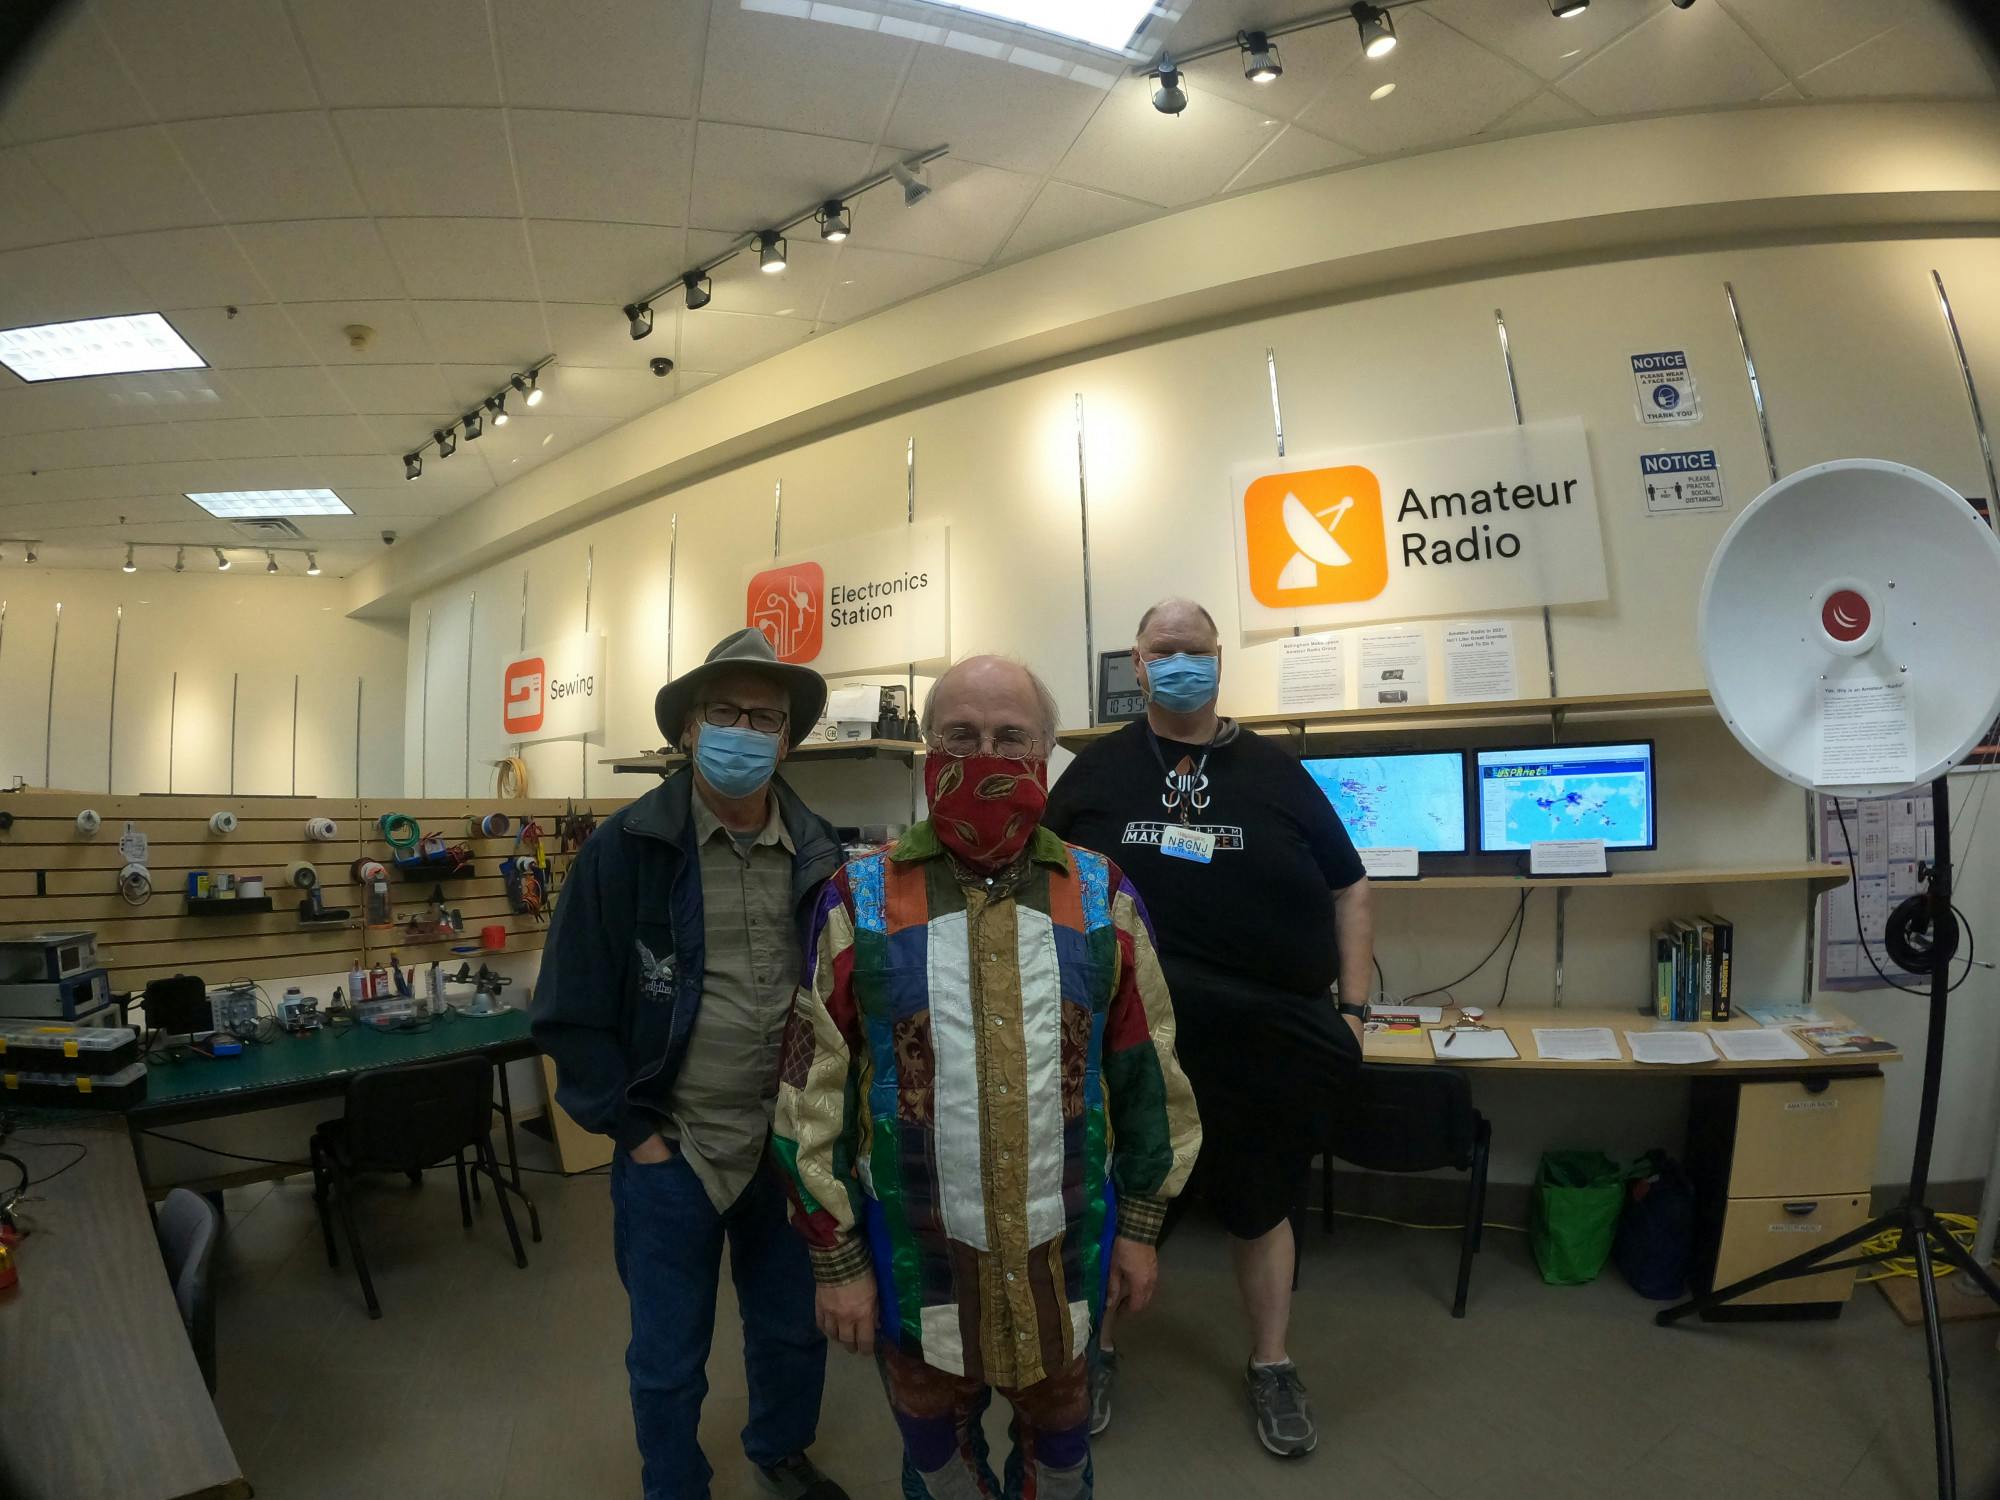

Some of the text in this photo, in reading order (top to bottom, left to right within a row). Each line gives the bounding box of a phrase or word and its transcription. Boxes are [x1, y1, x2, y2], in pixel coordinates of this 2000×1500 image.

[1633, 355, 1685, 369] NOTICE
[1645, 453, 1712, 471] NOTICE
[1397, 479, 1577, 523] Amateur
[1685, 496, 1721, 504] DISTANCING
[1402, 525, 1521, 567] Radio
[830, 572, 928, 606] Electronics
[830, 603, 893, 629] Station
[550, 673, 594, 699] Sewing
[1705, 954, 1713, 996] HANDBOOK
